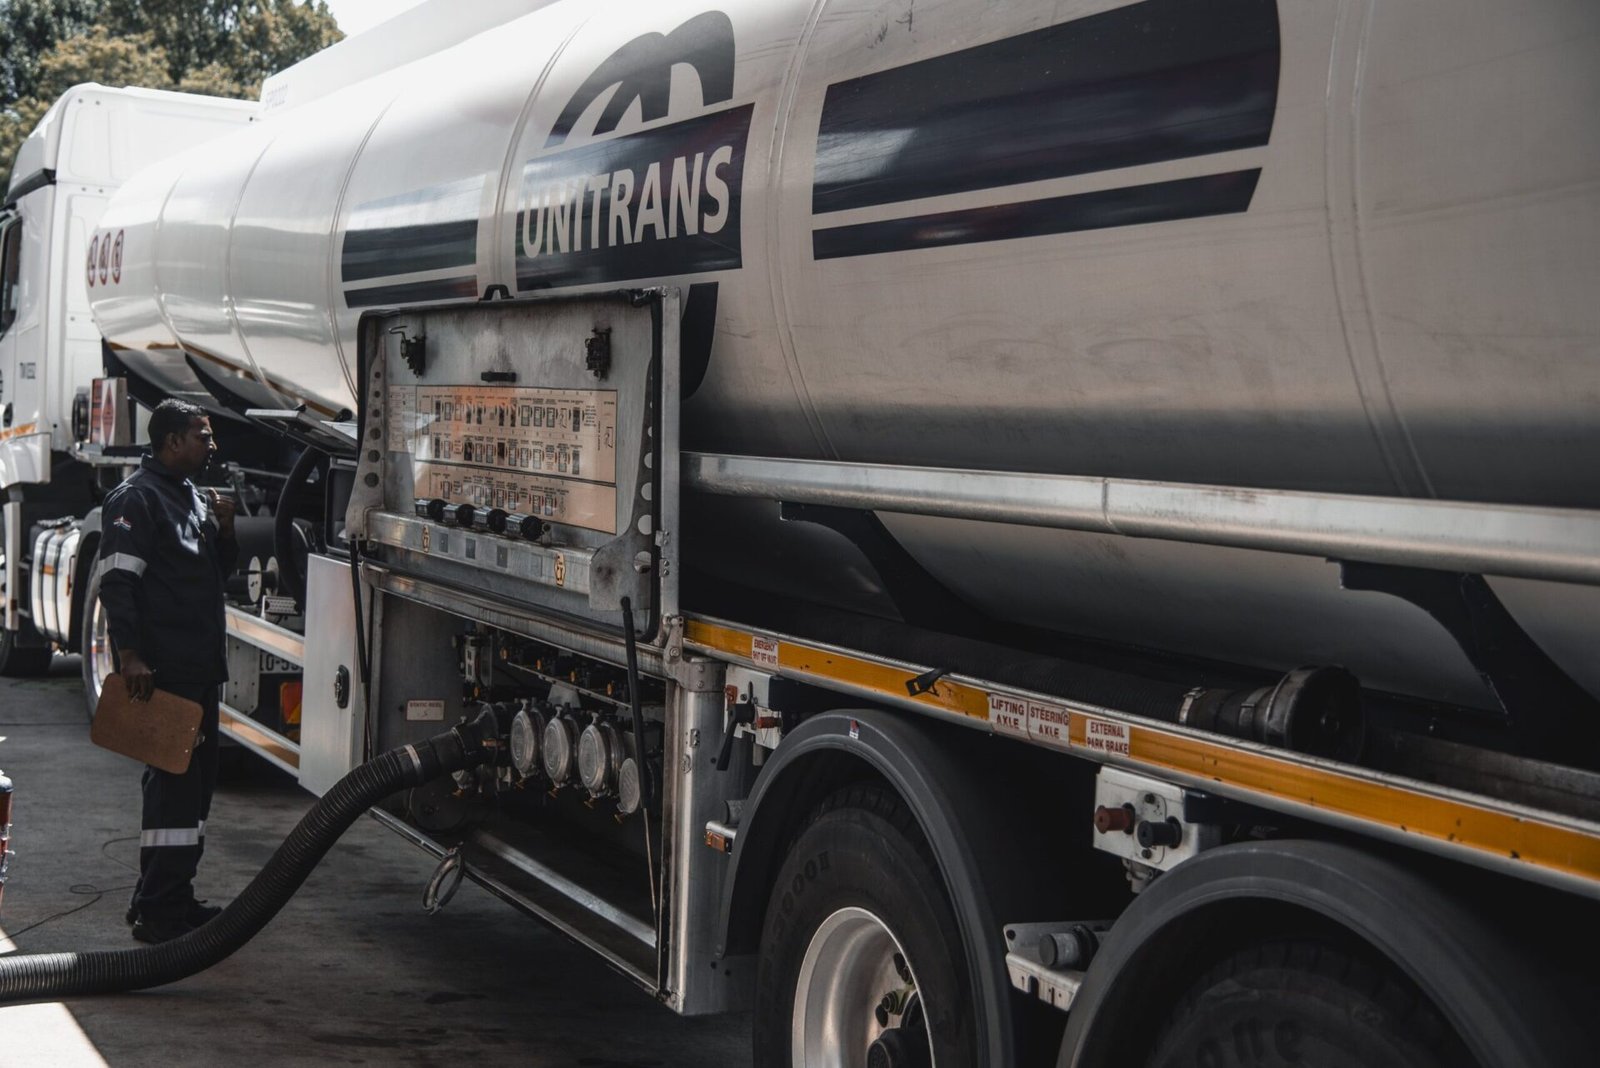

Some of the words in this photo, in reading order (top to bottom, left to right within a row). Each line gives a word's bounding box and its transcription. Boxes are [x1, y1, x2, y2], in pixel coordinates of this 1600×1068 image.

[522, 145, 733, 258] UNITRANS
[991, 697, 1025, 715] LIFTING
[996, 714, 1020, 729] AXLE
[1030, 708, 1069, 726] STEERING
[1038, 725, 1060, 739] AXLE
[1090, 721, 1125, 738] EXTERNAL
[1087, 736, 1104, 750] PARK
[1105, 741, 1129, 755] BRAKE
